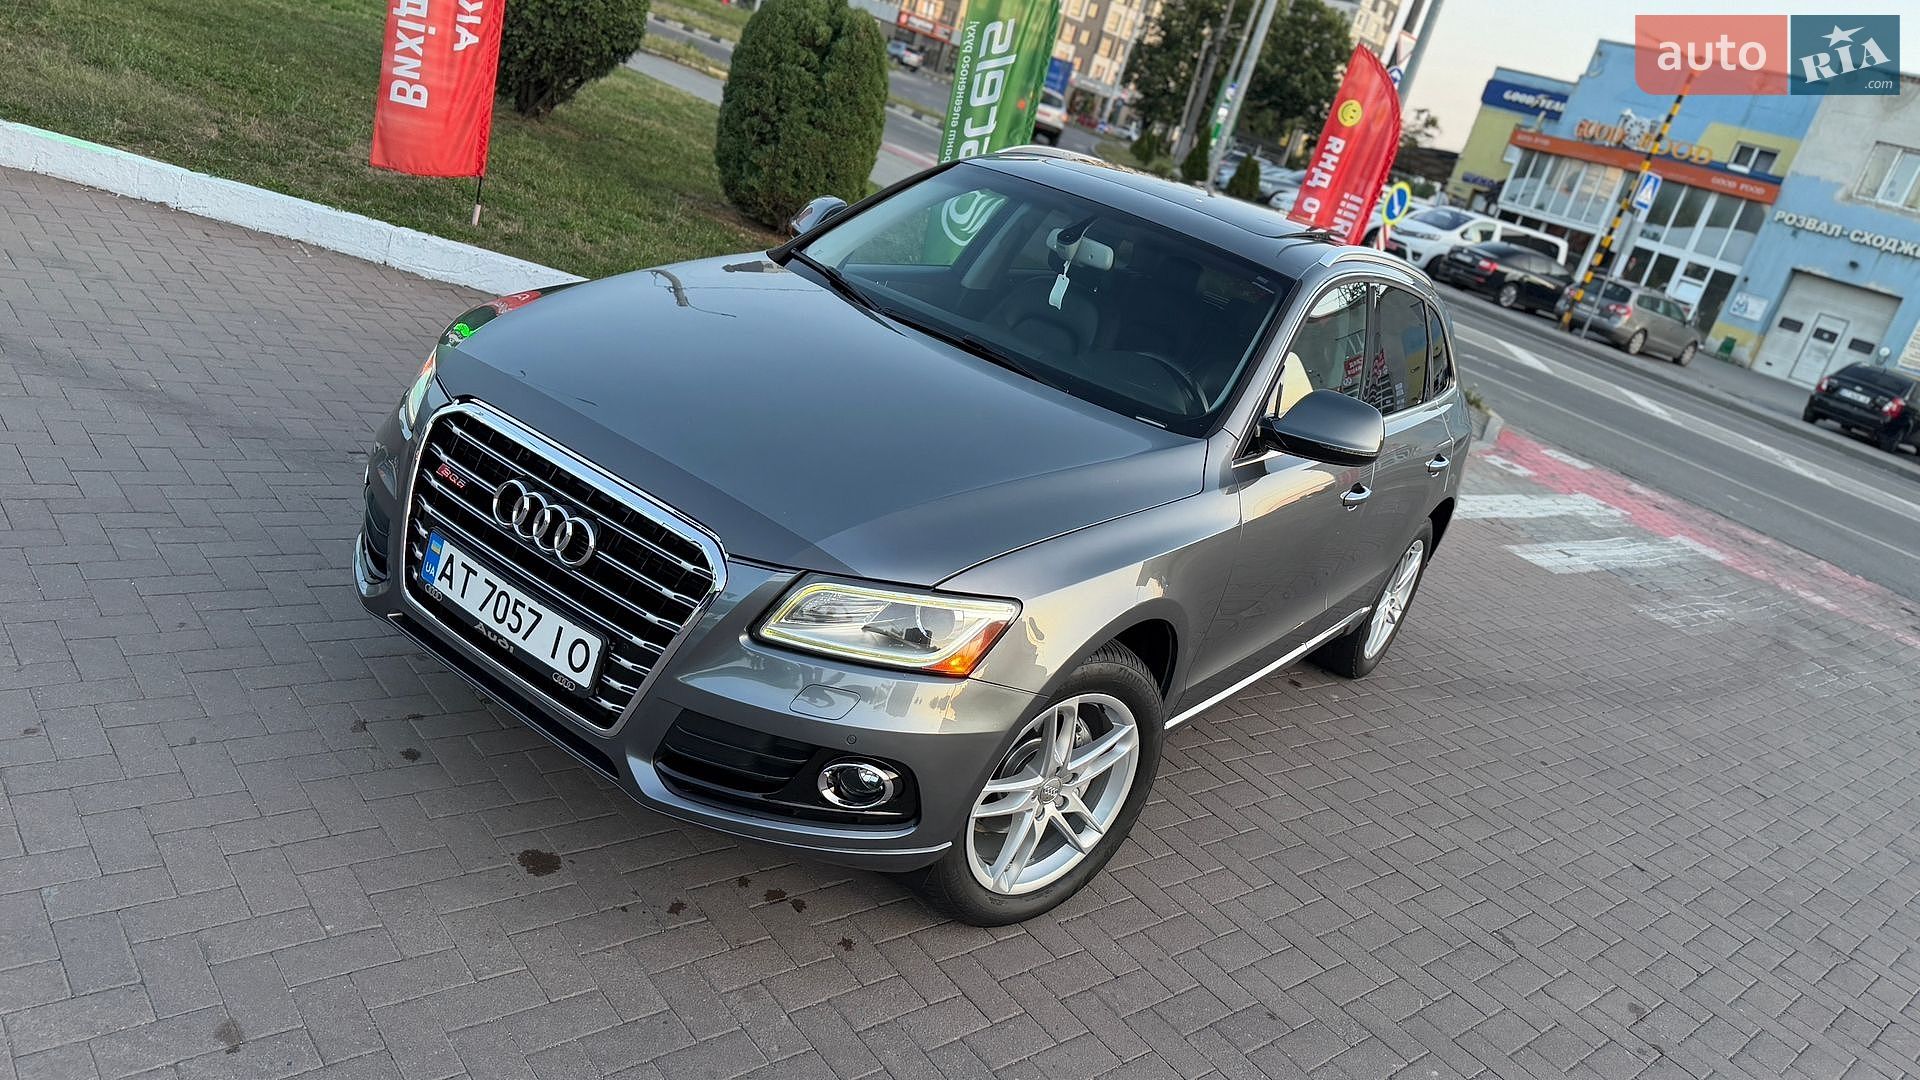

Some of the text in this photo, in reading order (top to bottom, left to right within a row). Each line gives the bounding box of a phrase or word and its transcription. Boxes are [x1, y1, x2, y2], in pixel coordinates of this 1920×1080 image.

[425, 562, 435, 577] UA
[438, 554, 591, 673] AT 7057 IO
